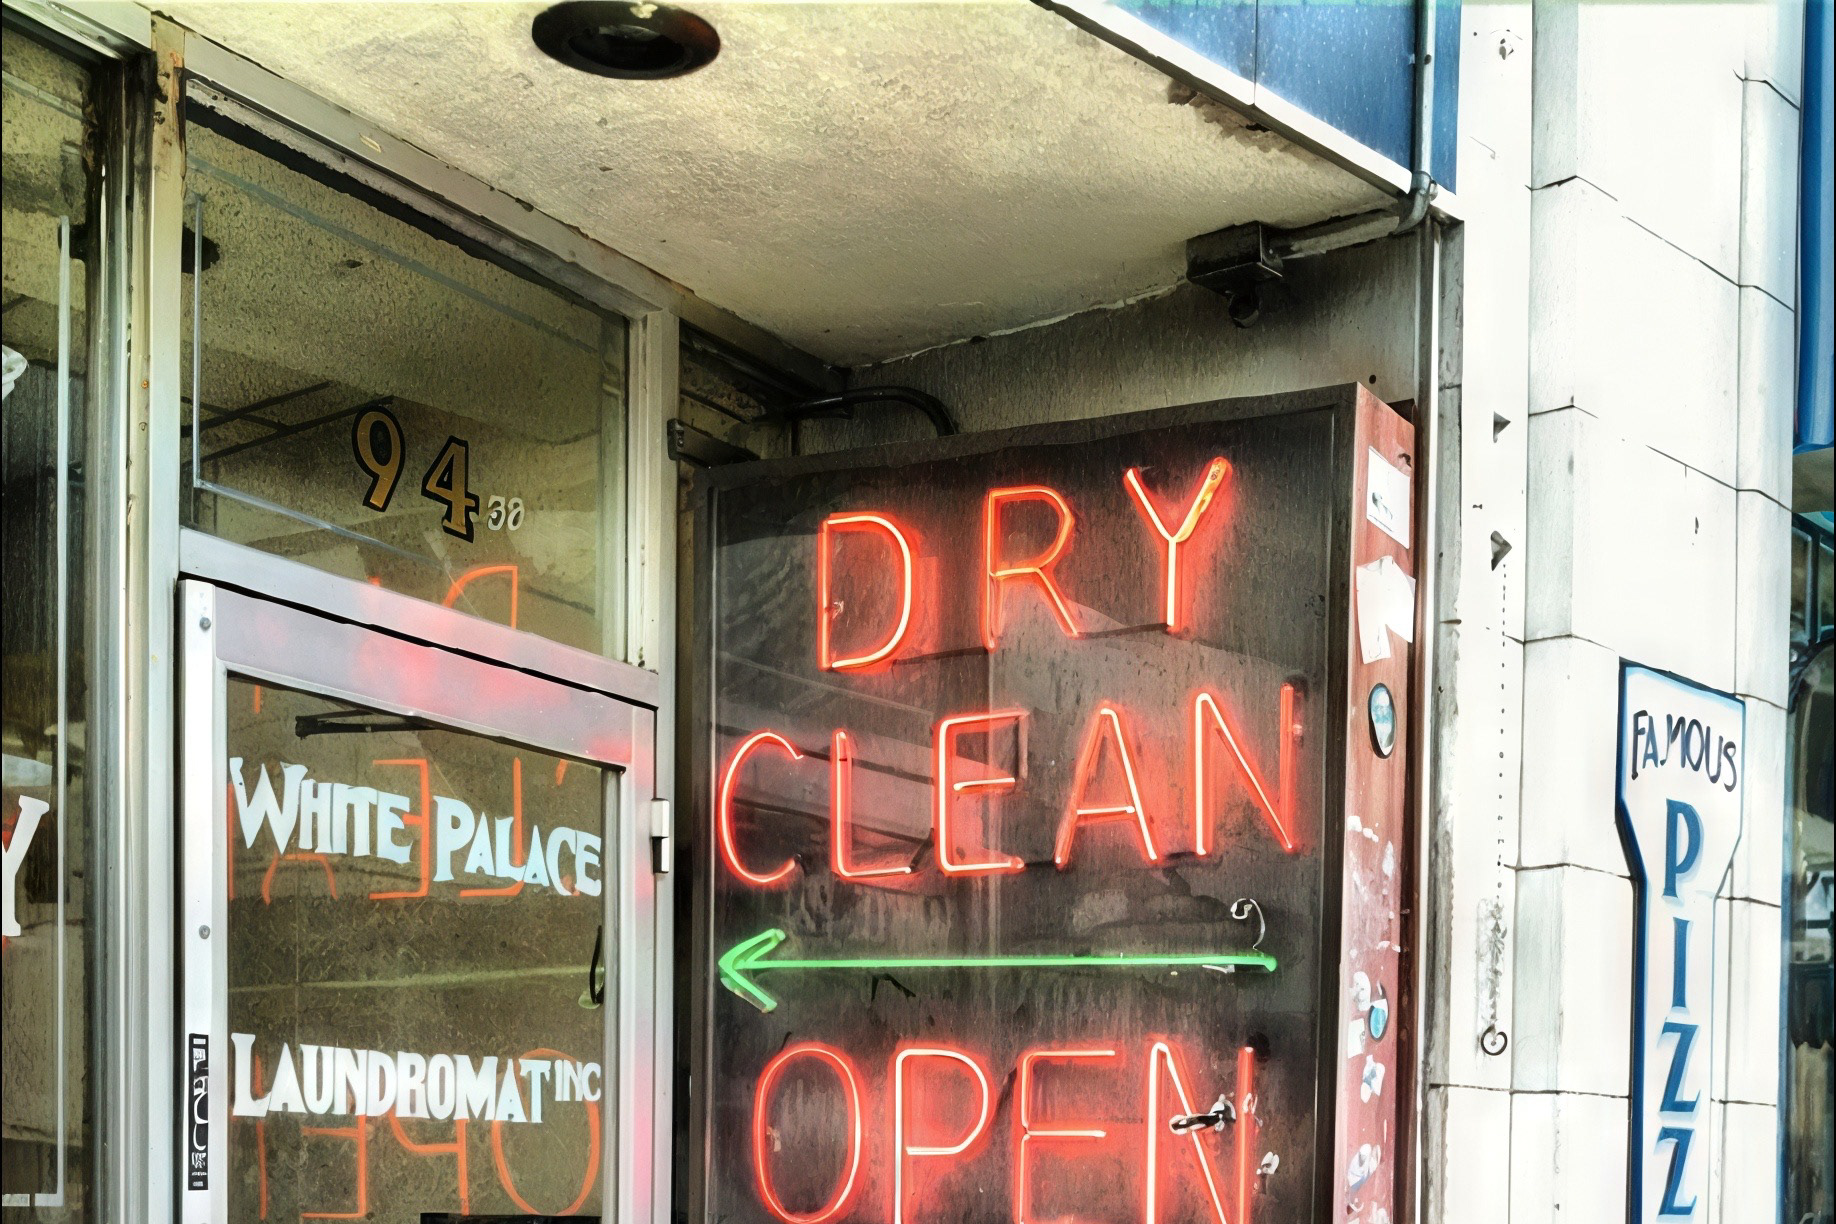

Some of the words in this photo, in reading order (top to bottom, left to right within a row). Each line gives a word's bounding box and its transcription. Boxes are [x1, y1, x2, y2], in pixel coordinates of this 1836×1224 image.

[817, 455, 1232, 672] DRY
[717, 682, 1298, 883] CLEAN
[1631, 709, 1737, 793] FAMOUS
[229, 757, 411, 865] WHITE
[433, 795, 602, 896] PALACE
[231, 1032, 550, 1124] LAUNDROMAT
[554, 1058, 602, 1102] INC
